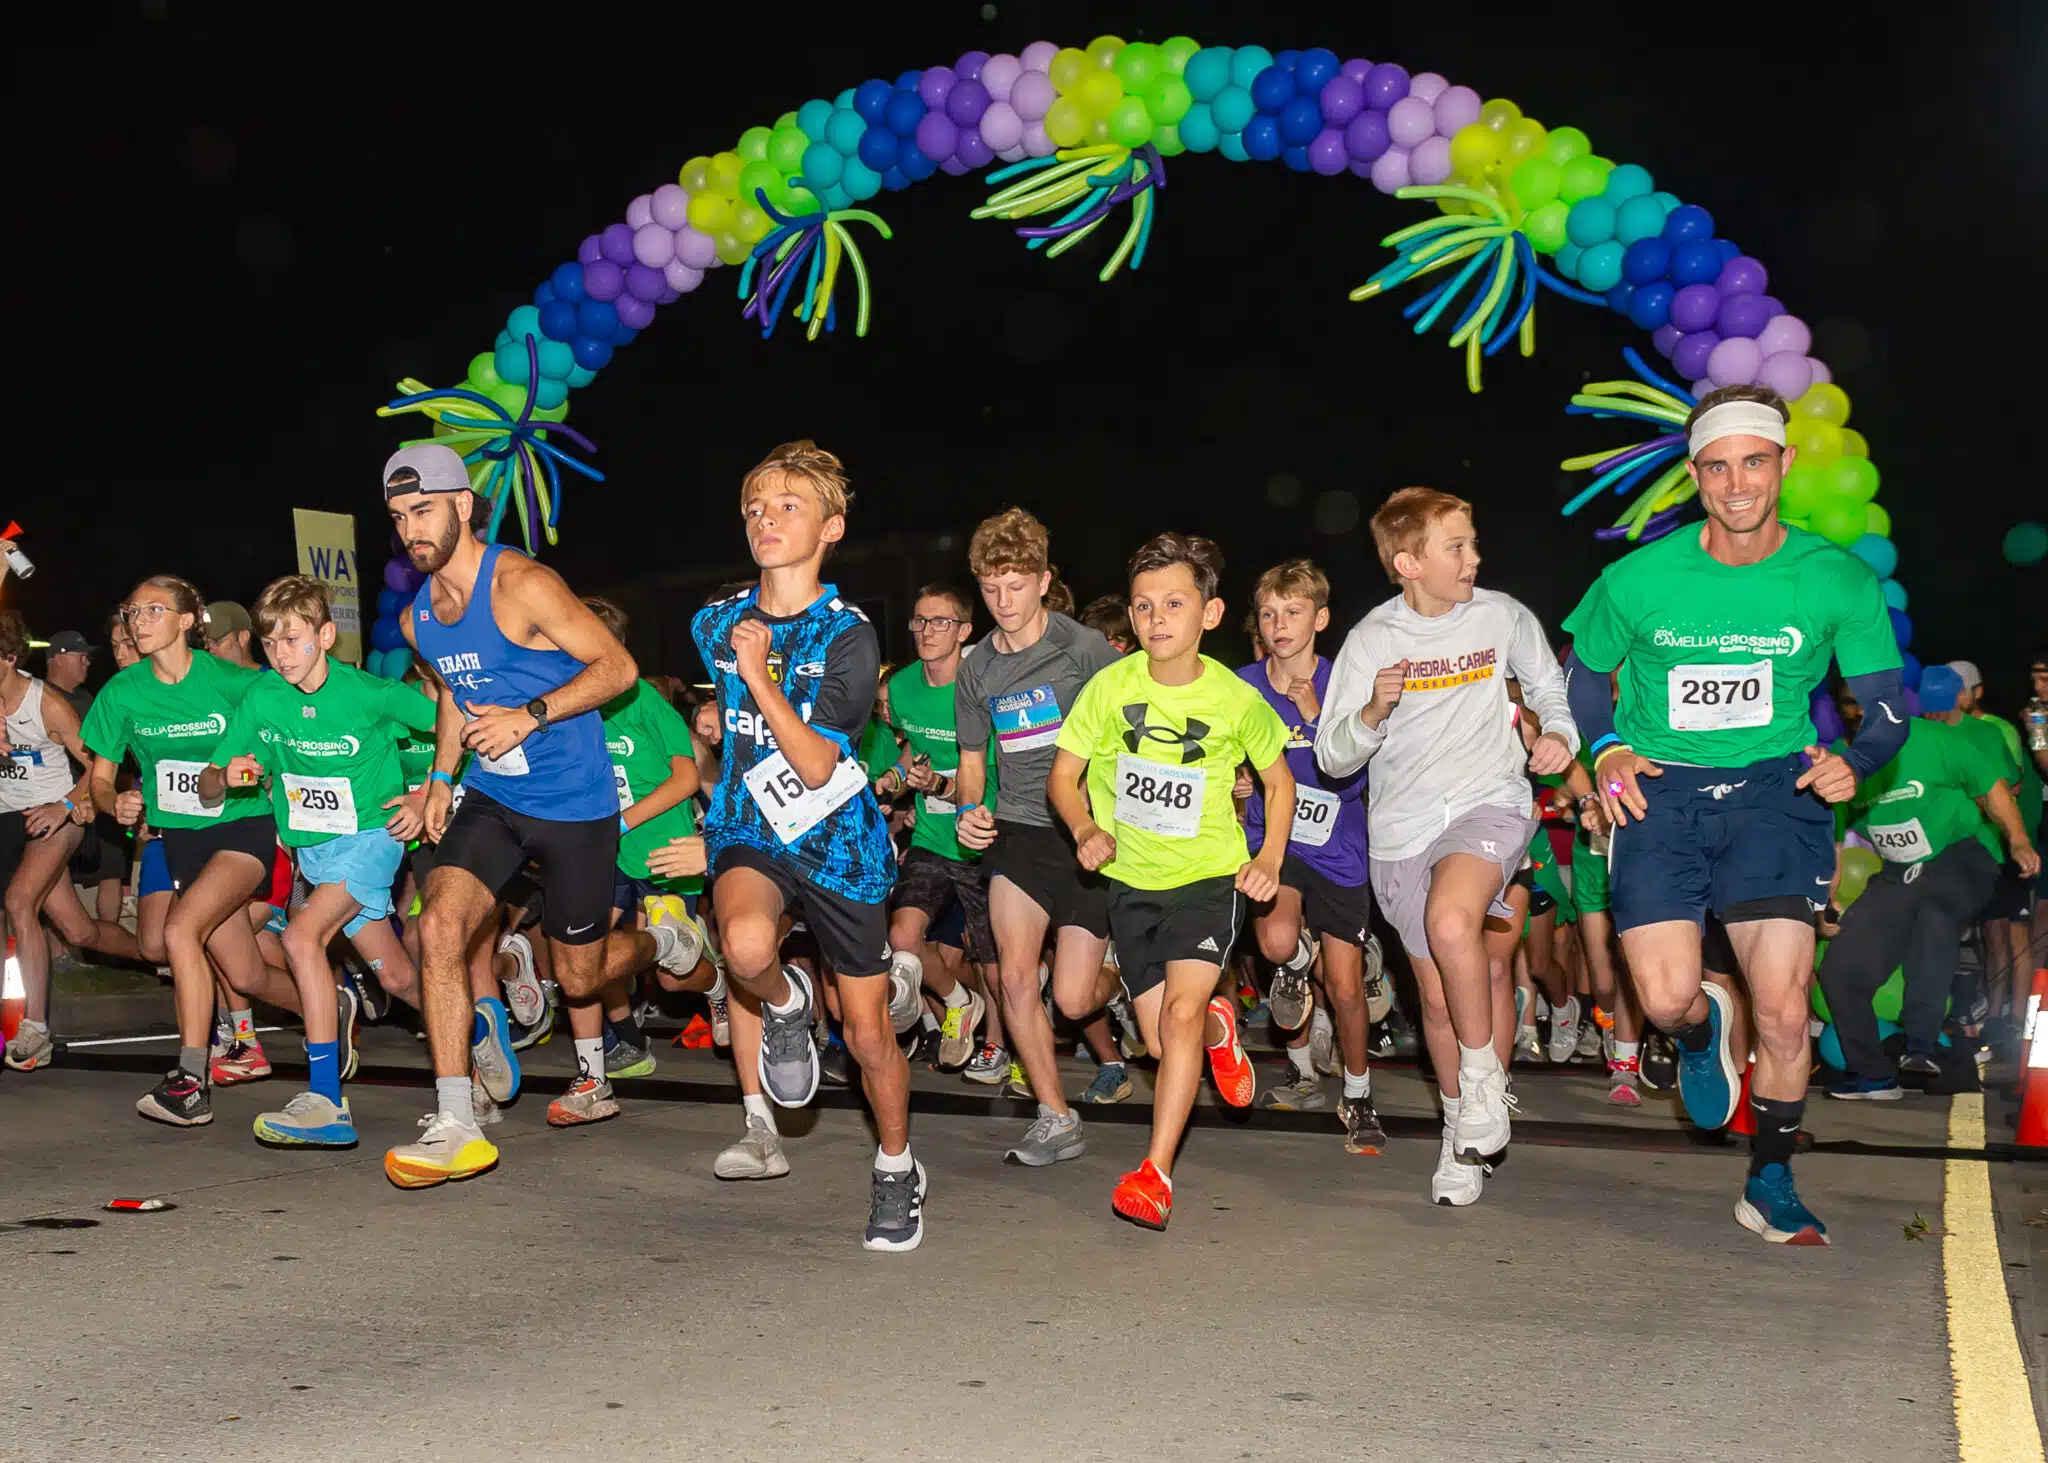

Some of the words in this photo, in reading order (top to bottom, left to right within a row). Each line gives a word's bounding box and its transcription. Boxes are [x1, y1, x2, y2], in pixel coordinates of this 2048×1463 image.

[1653, 635, 1719, 648] CAMELLIA
[1719, 634, 1791, 648] CROSSING
[436, 652, 482, 674] ERATH
[1393, 648, 1497, 678] THEDRAL-CARMEL
[1681, 678, 1760, 706] 2870
[167, 719, 218, 733] CROSSING
[1018, 708, 1031, 730] 4
[300, 787, 340, 811] 259
[1125, 772, 1193, 809] 2848
[1874, 830, 1919, 848] 2430
